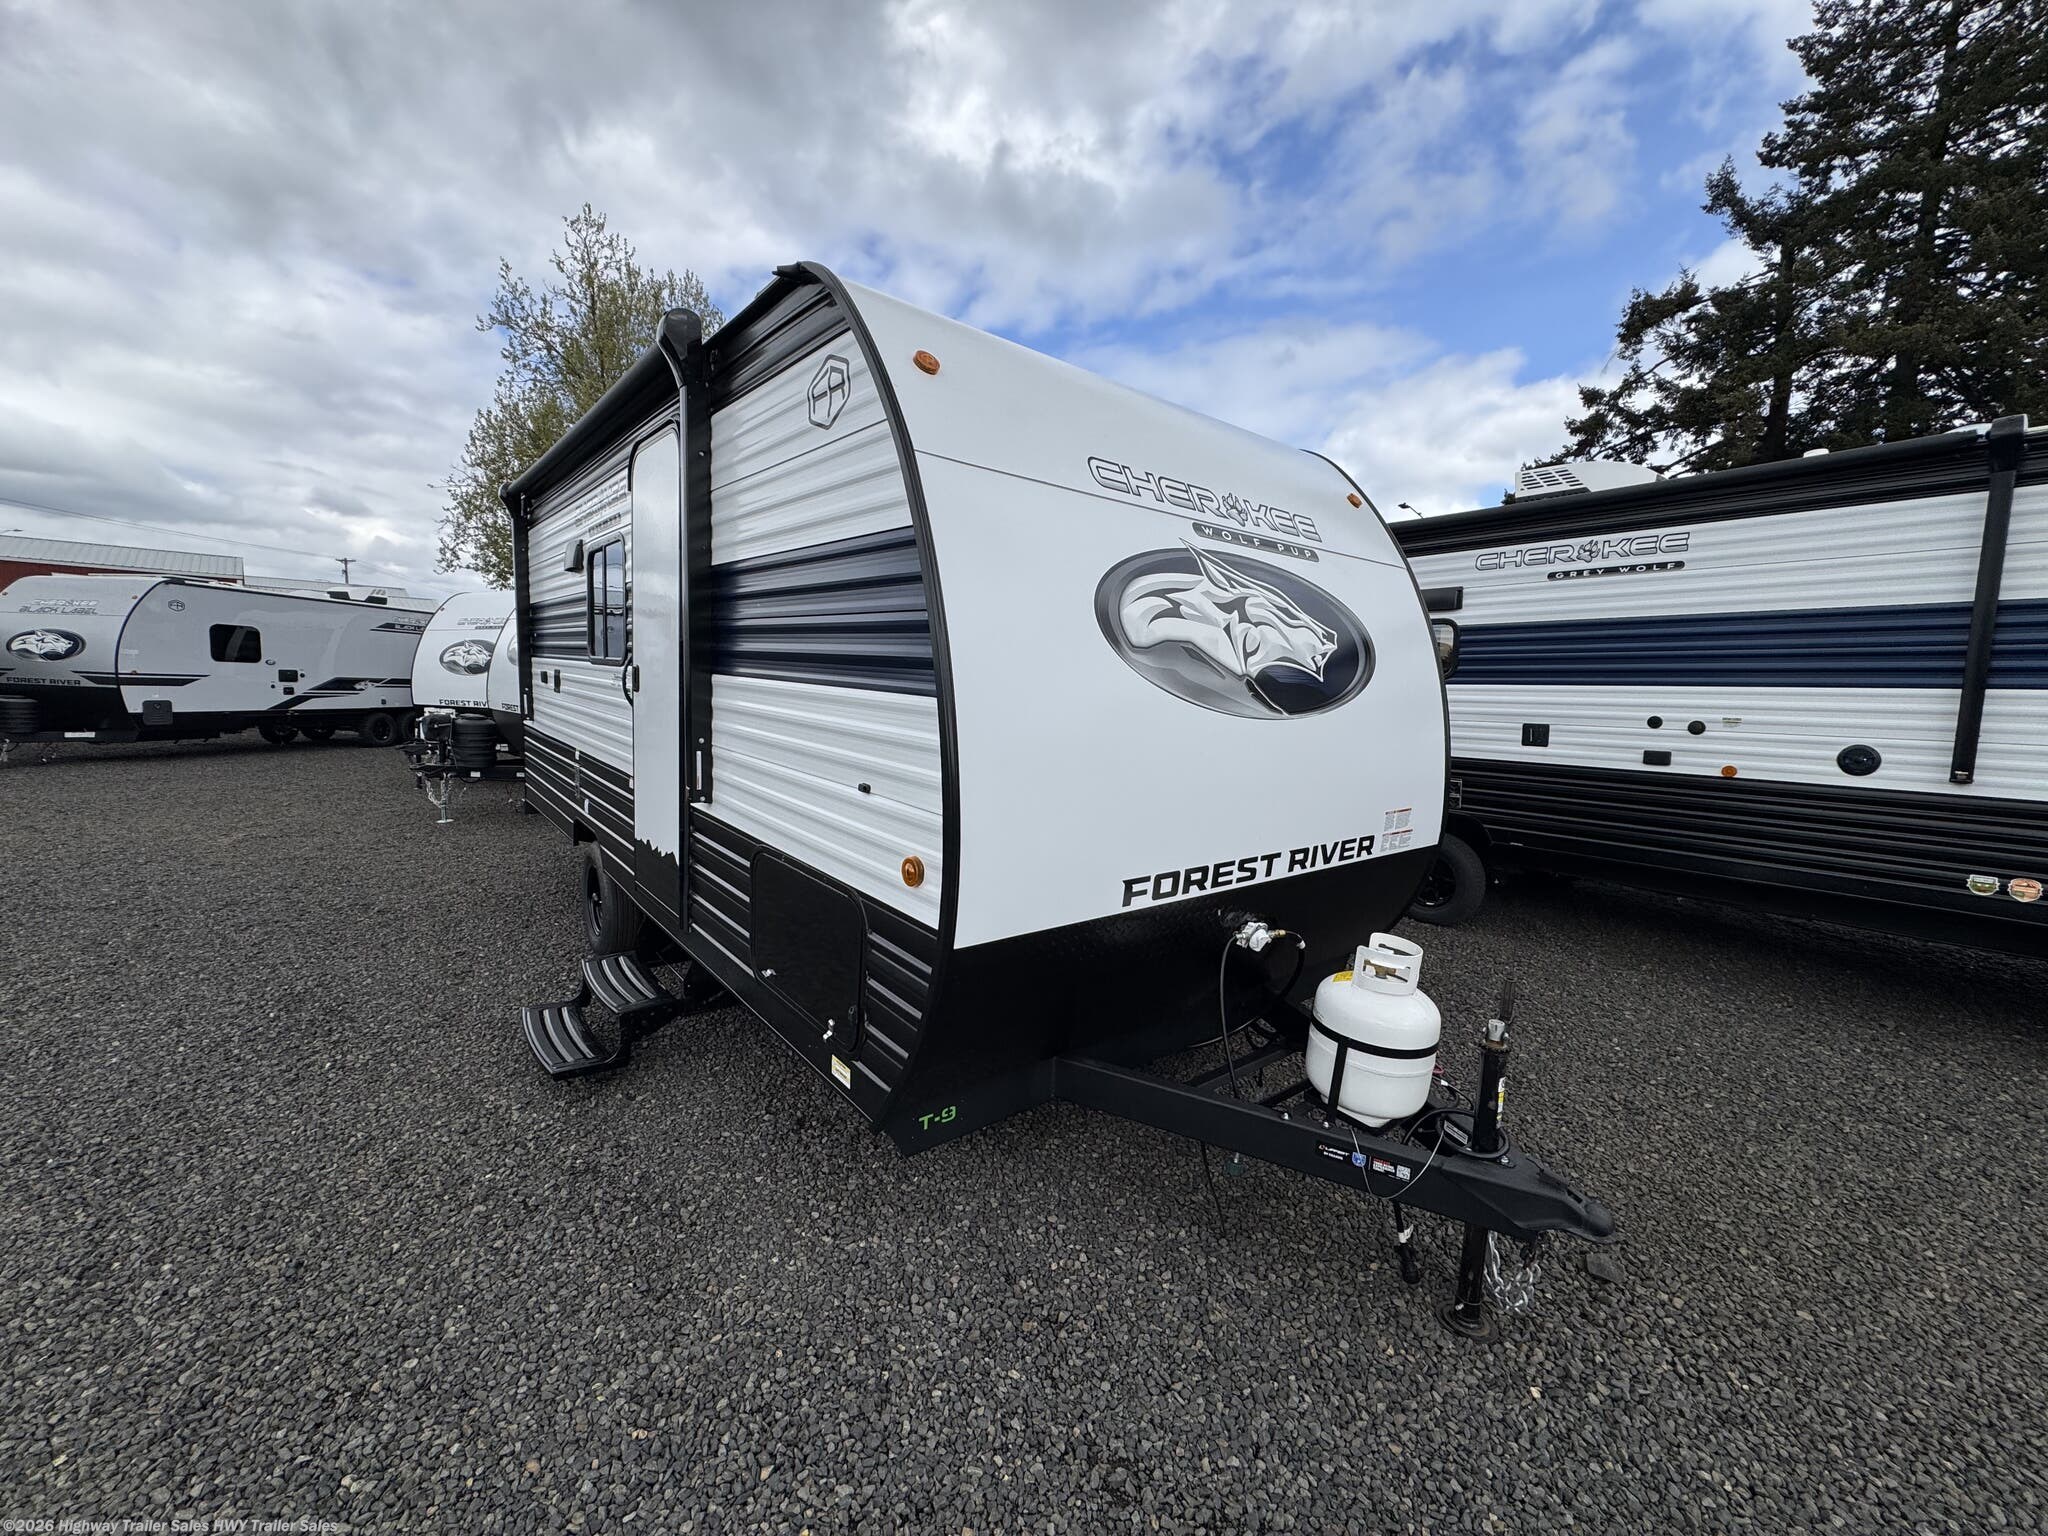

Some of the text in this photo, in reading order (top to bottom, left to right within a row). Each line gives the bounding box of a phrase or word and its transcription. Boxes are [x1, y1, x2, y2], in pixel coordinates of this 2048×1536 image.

[1202, 525, 1312, 559] WOLF PUP
[1555, 562, 1676, 579] GREY WOLF
[6, 676, 81, 686] FOREST RIVER
[1121, 852, 1282, 908] FOREST
[1287, 834, 1375, 873] RIVER
